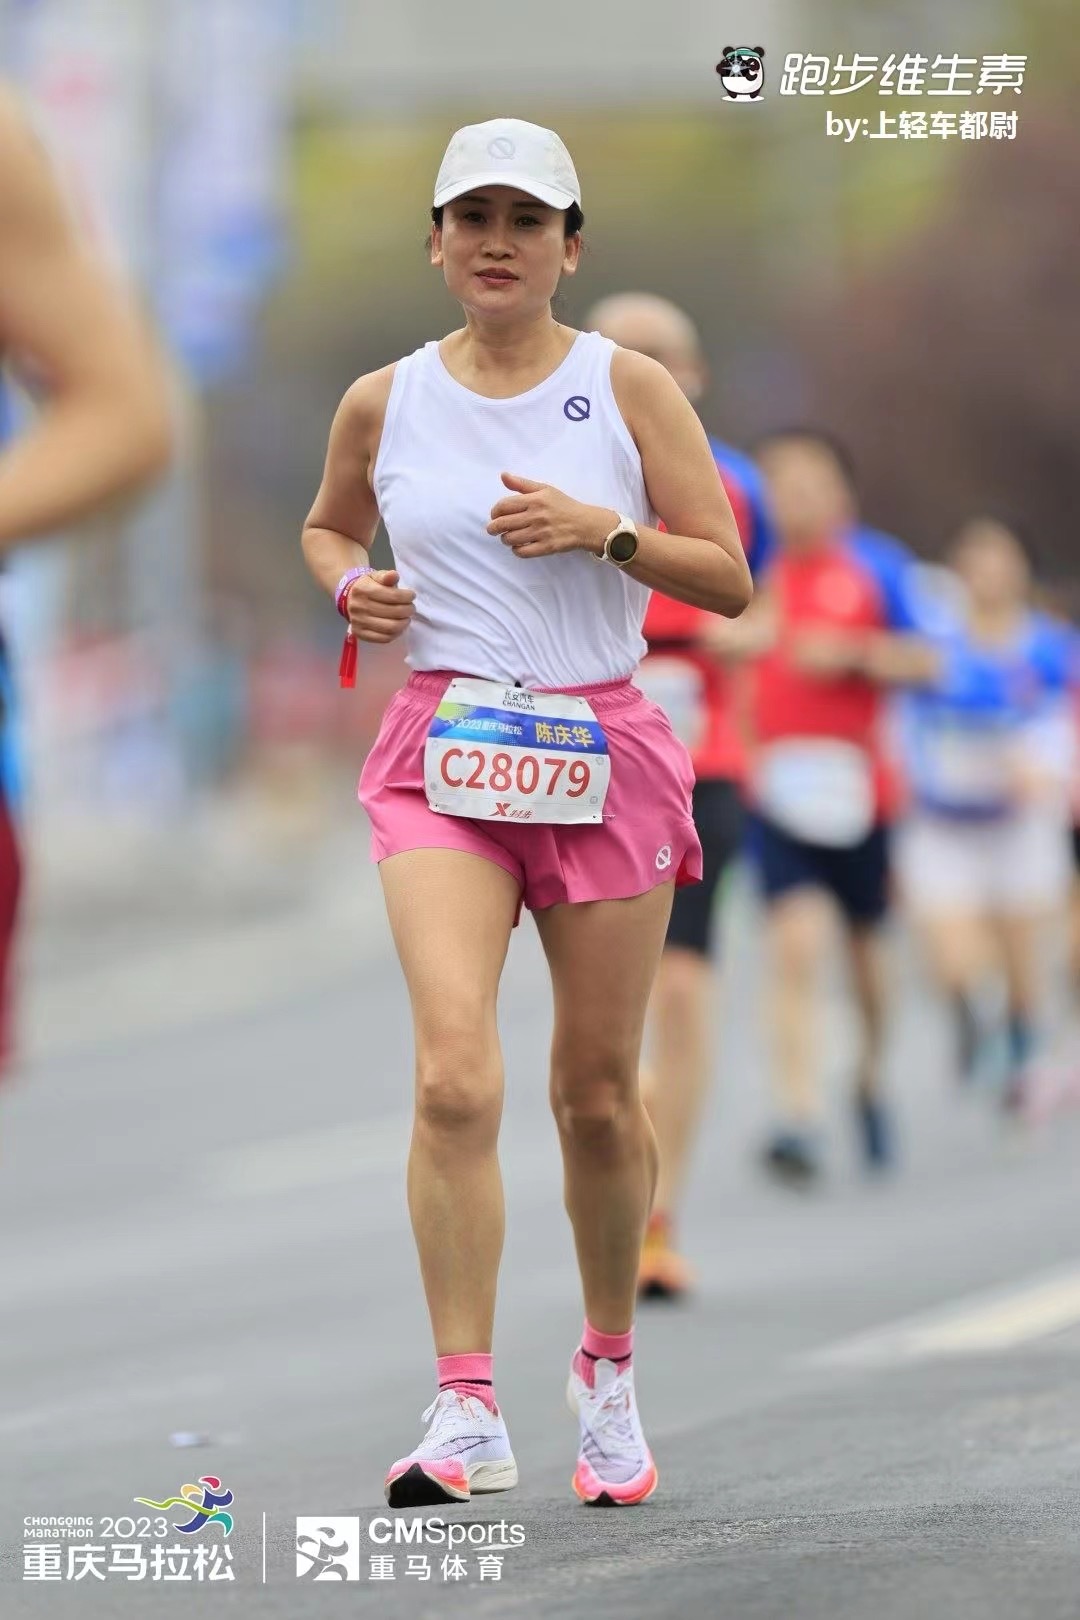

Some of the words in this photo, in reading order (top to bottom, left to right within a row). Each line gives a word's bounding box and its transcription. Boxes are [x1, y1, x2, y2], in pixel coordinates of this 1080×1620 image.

[502, 699, 536, 711] CHANGAN
[535, 721, 595, 748] 陈庆华
[440, 748, 591, 798] C28079
